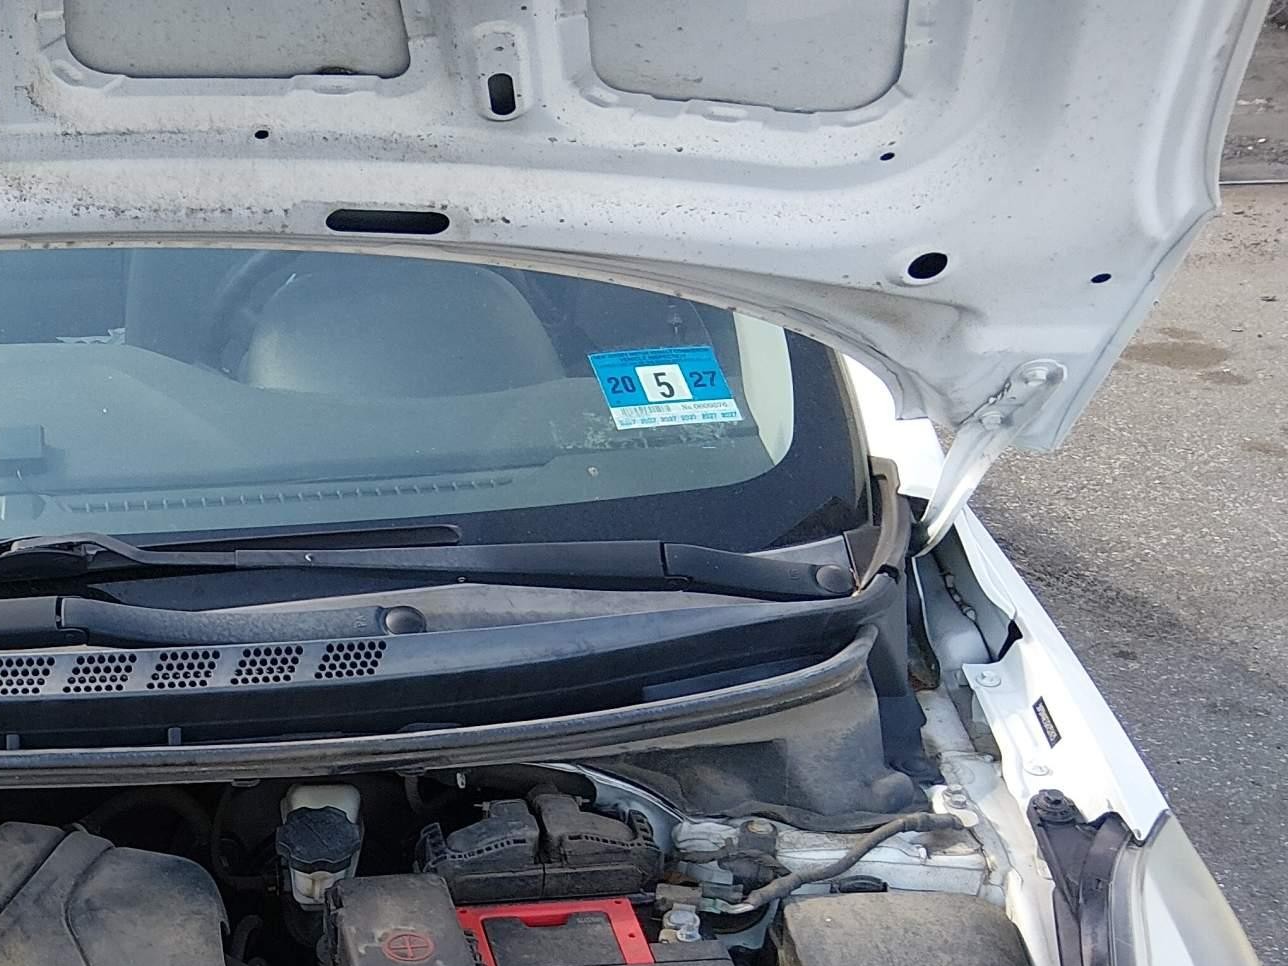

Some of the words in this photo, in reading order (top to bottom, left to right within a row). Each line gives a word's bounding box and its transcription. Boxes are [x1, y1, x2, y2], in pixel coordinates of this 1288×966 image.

[607, 375, 636, 394] 20
[653, 372, 675, 398] 5
[689, 371, 716, 388] 27
